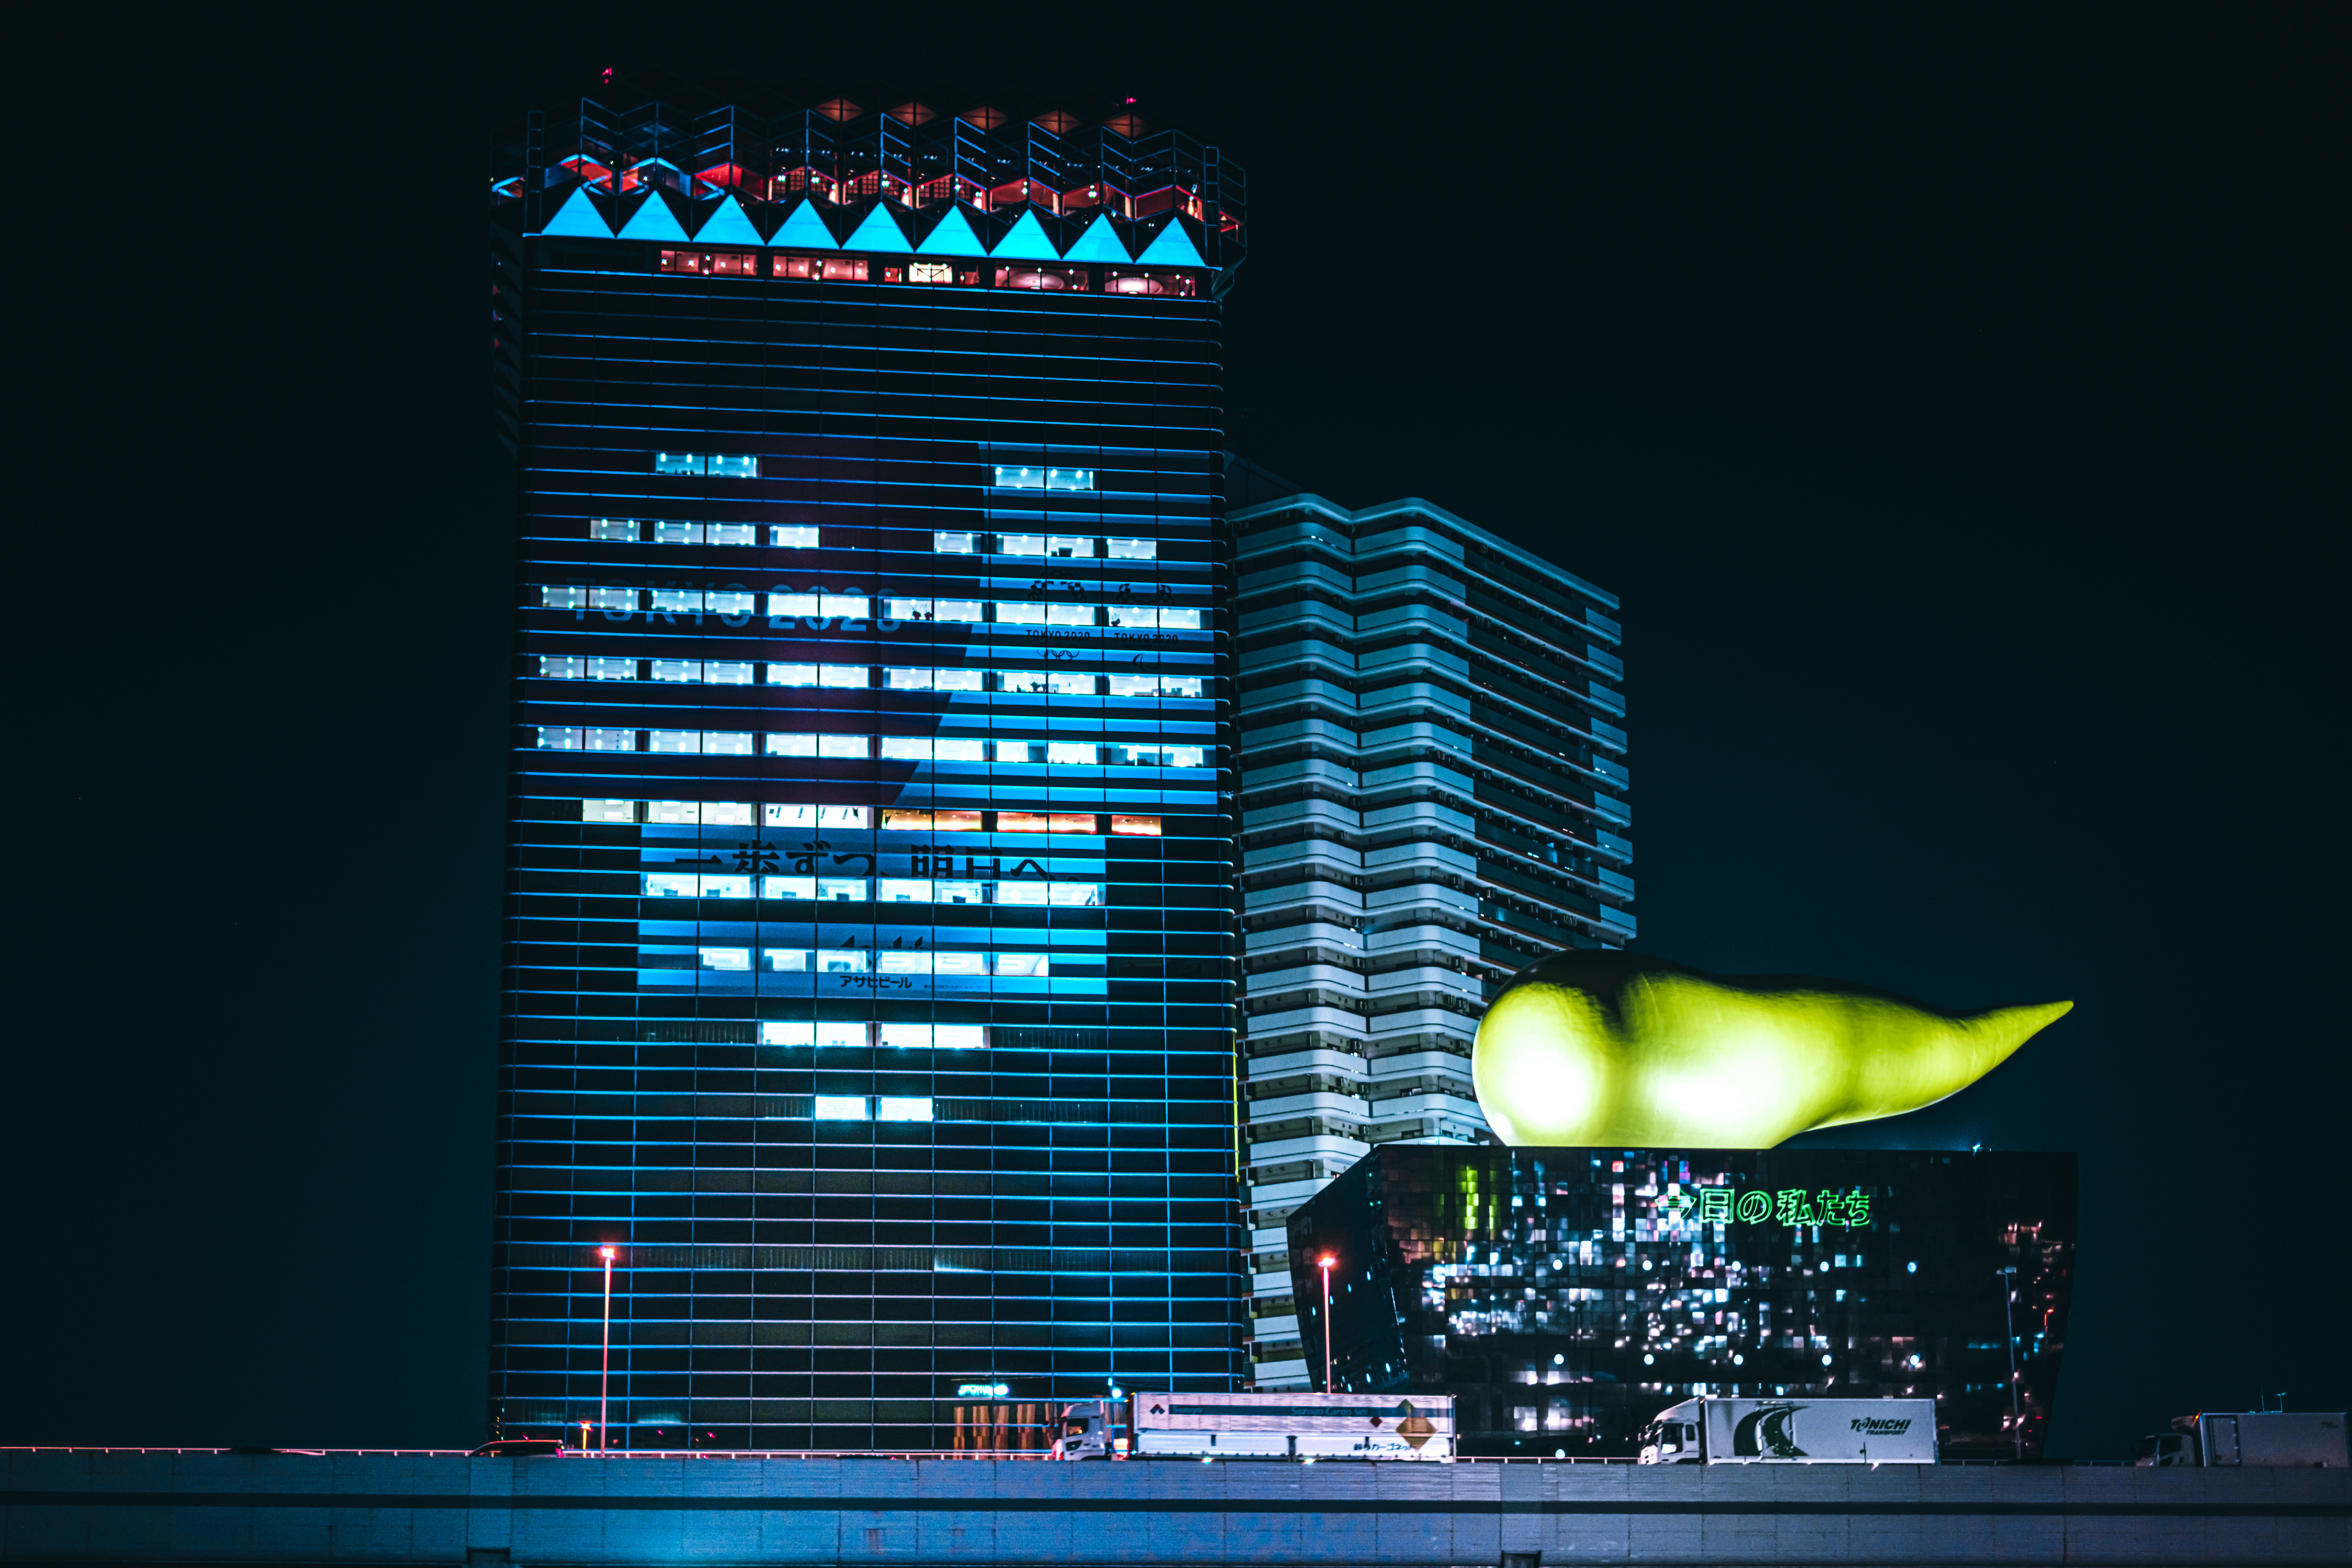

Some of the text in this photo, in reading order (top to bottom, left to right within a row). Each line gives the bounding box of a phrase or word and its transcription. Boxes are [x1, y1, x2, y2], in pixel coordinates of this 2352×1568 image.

[566, 578, 901, 633] TOKYO 2020
[1025, 629, 1090, 641] TOKYO 2020
[1114, 632, 1179, 644] TOKYO 2020
[840, 975, 912, 988] アサヒビール
[1654, 1187, 1870, 1227] 今日の私たち
